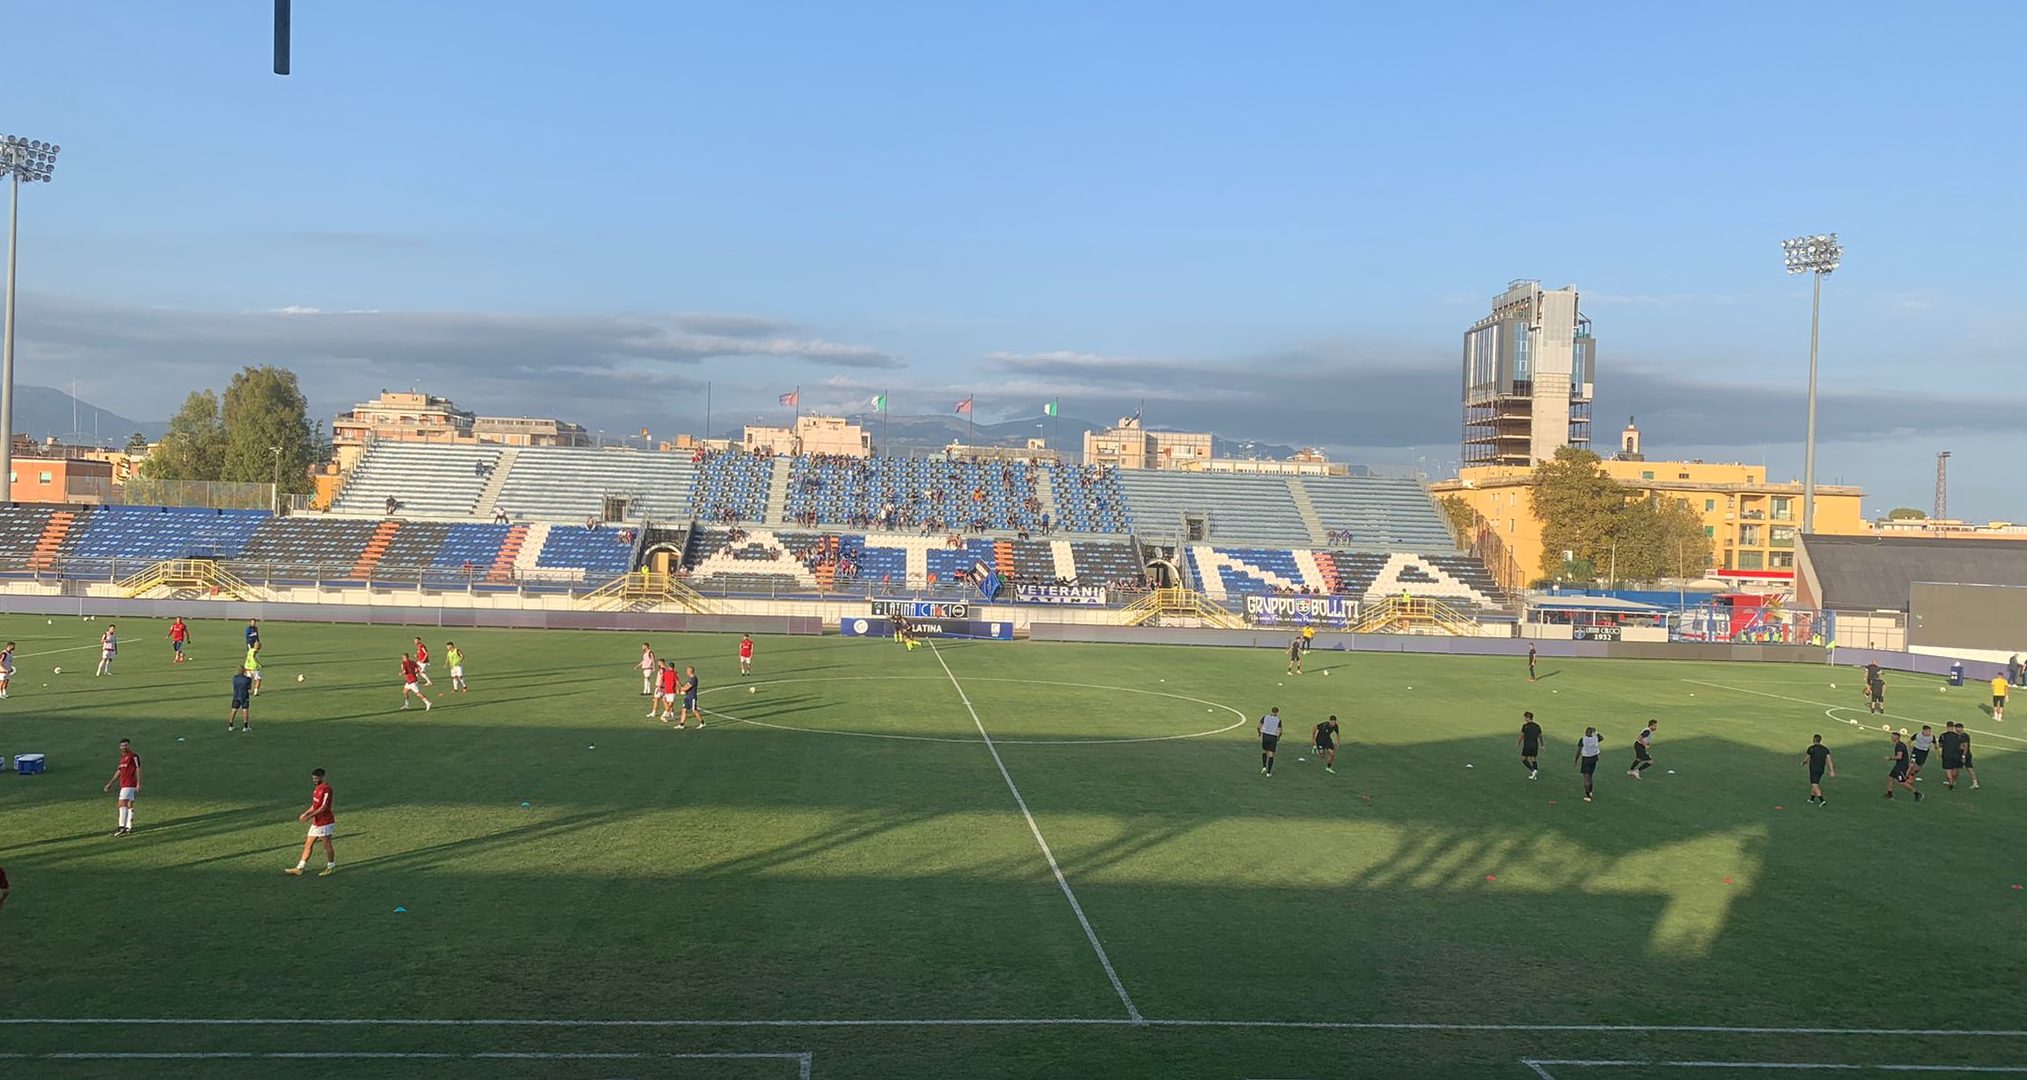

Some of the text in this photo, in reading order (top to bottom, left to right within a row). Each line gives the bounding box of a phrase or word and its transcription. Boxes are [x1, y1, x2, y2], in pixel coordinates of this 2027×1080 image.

[1016, 585, 1098, 597] VETERANI
[884, 602, 916, 616] LATINA
[1247, 596, 1295, 615] GRUPPO
[1312, 600, 1359, 618] BOLLITI
[912, 624, 942, 633] LATINA
